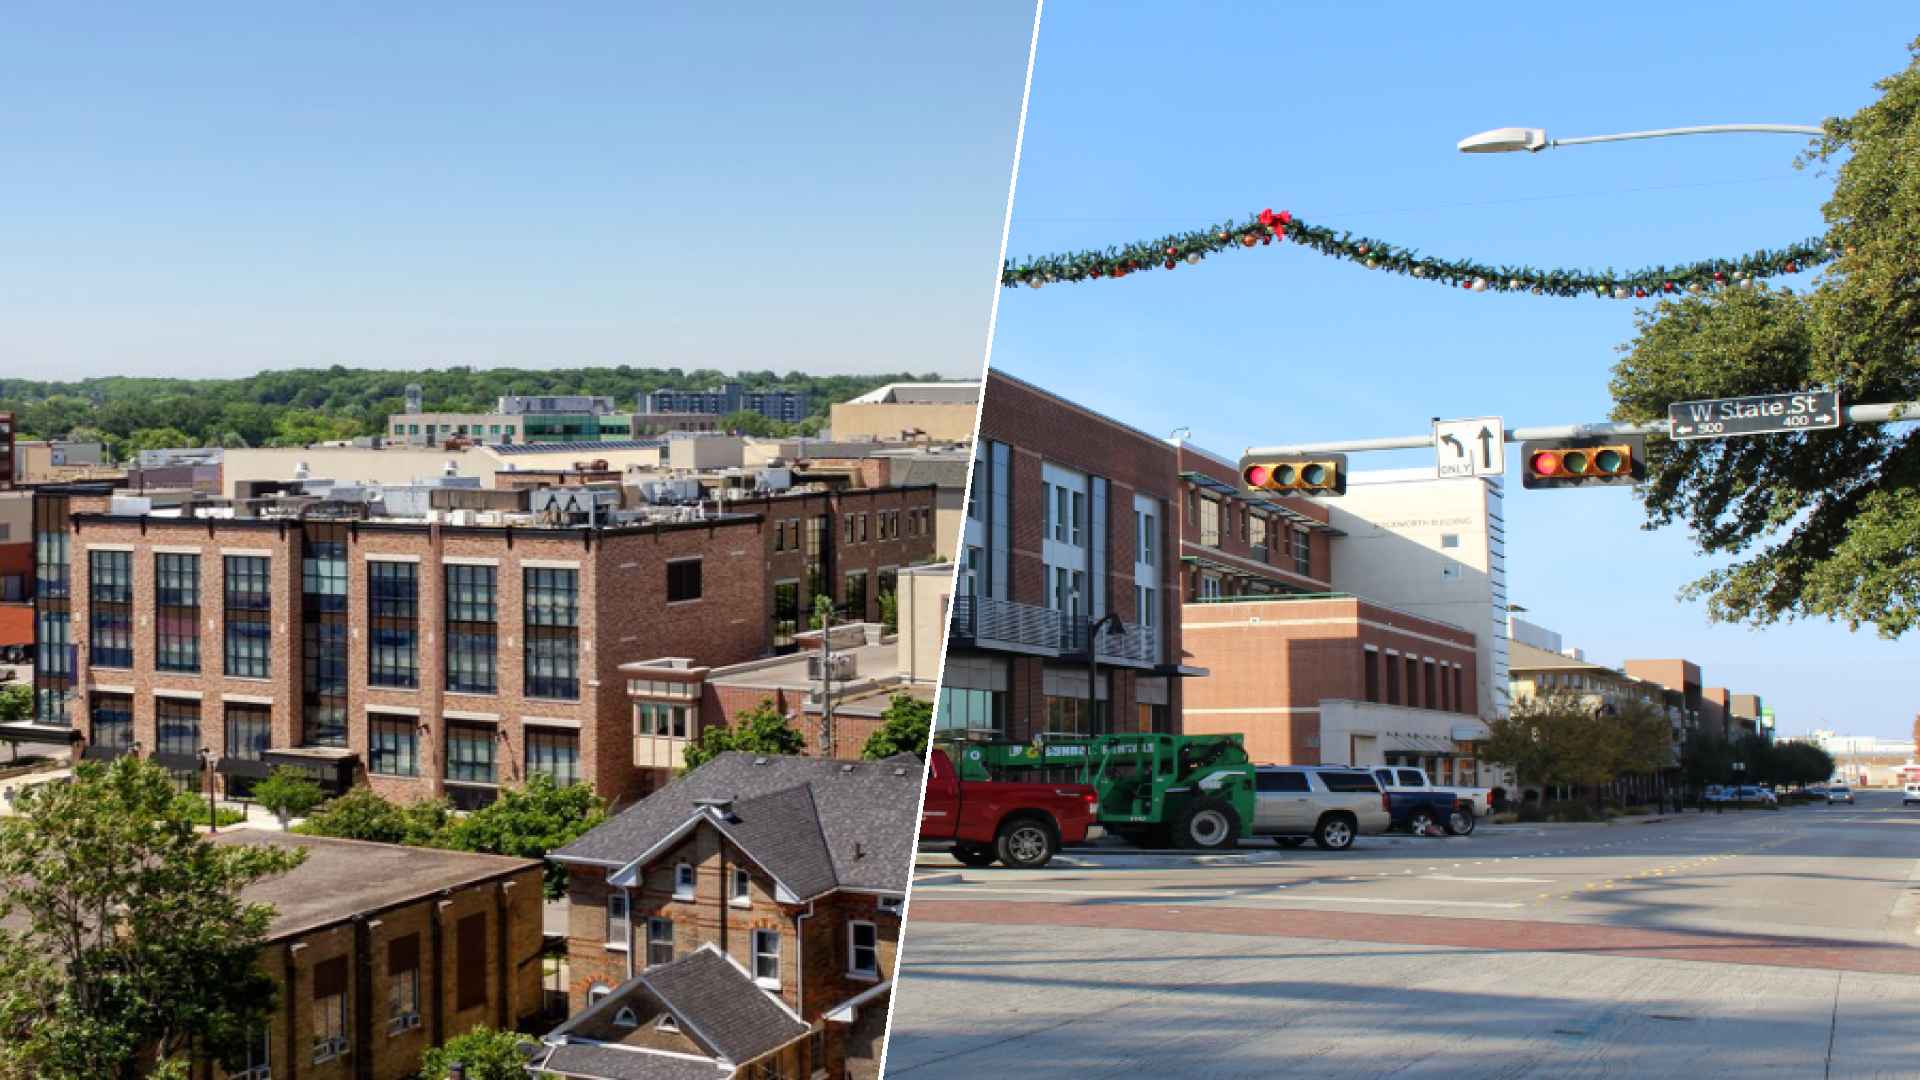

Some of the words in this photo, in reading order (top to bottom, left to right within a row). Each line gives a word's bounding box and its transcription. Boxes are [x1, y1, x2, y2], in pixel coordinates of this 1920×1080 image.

[1690, 403, 1713, 422] W
[1720, 399, 1784, 420] State
[1791, 395, 1817, 415] St
[1783, 415, 1809, 427] 400
[1697, 422, 1725, 434] 500
[1440, 463, 1471, 474] ONLY
